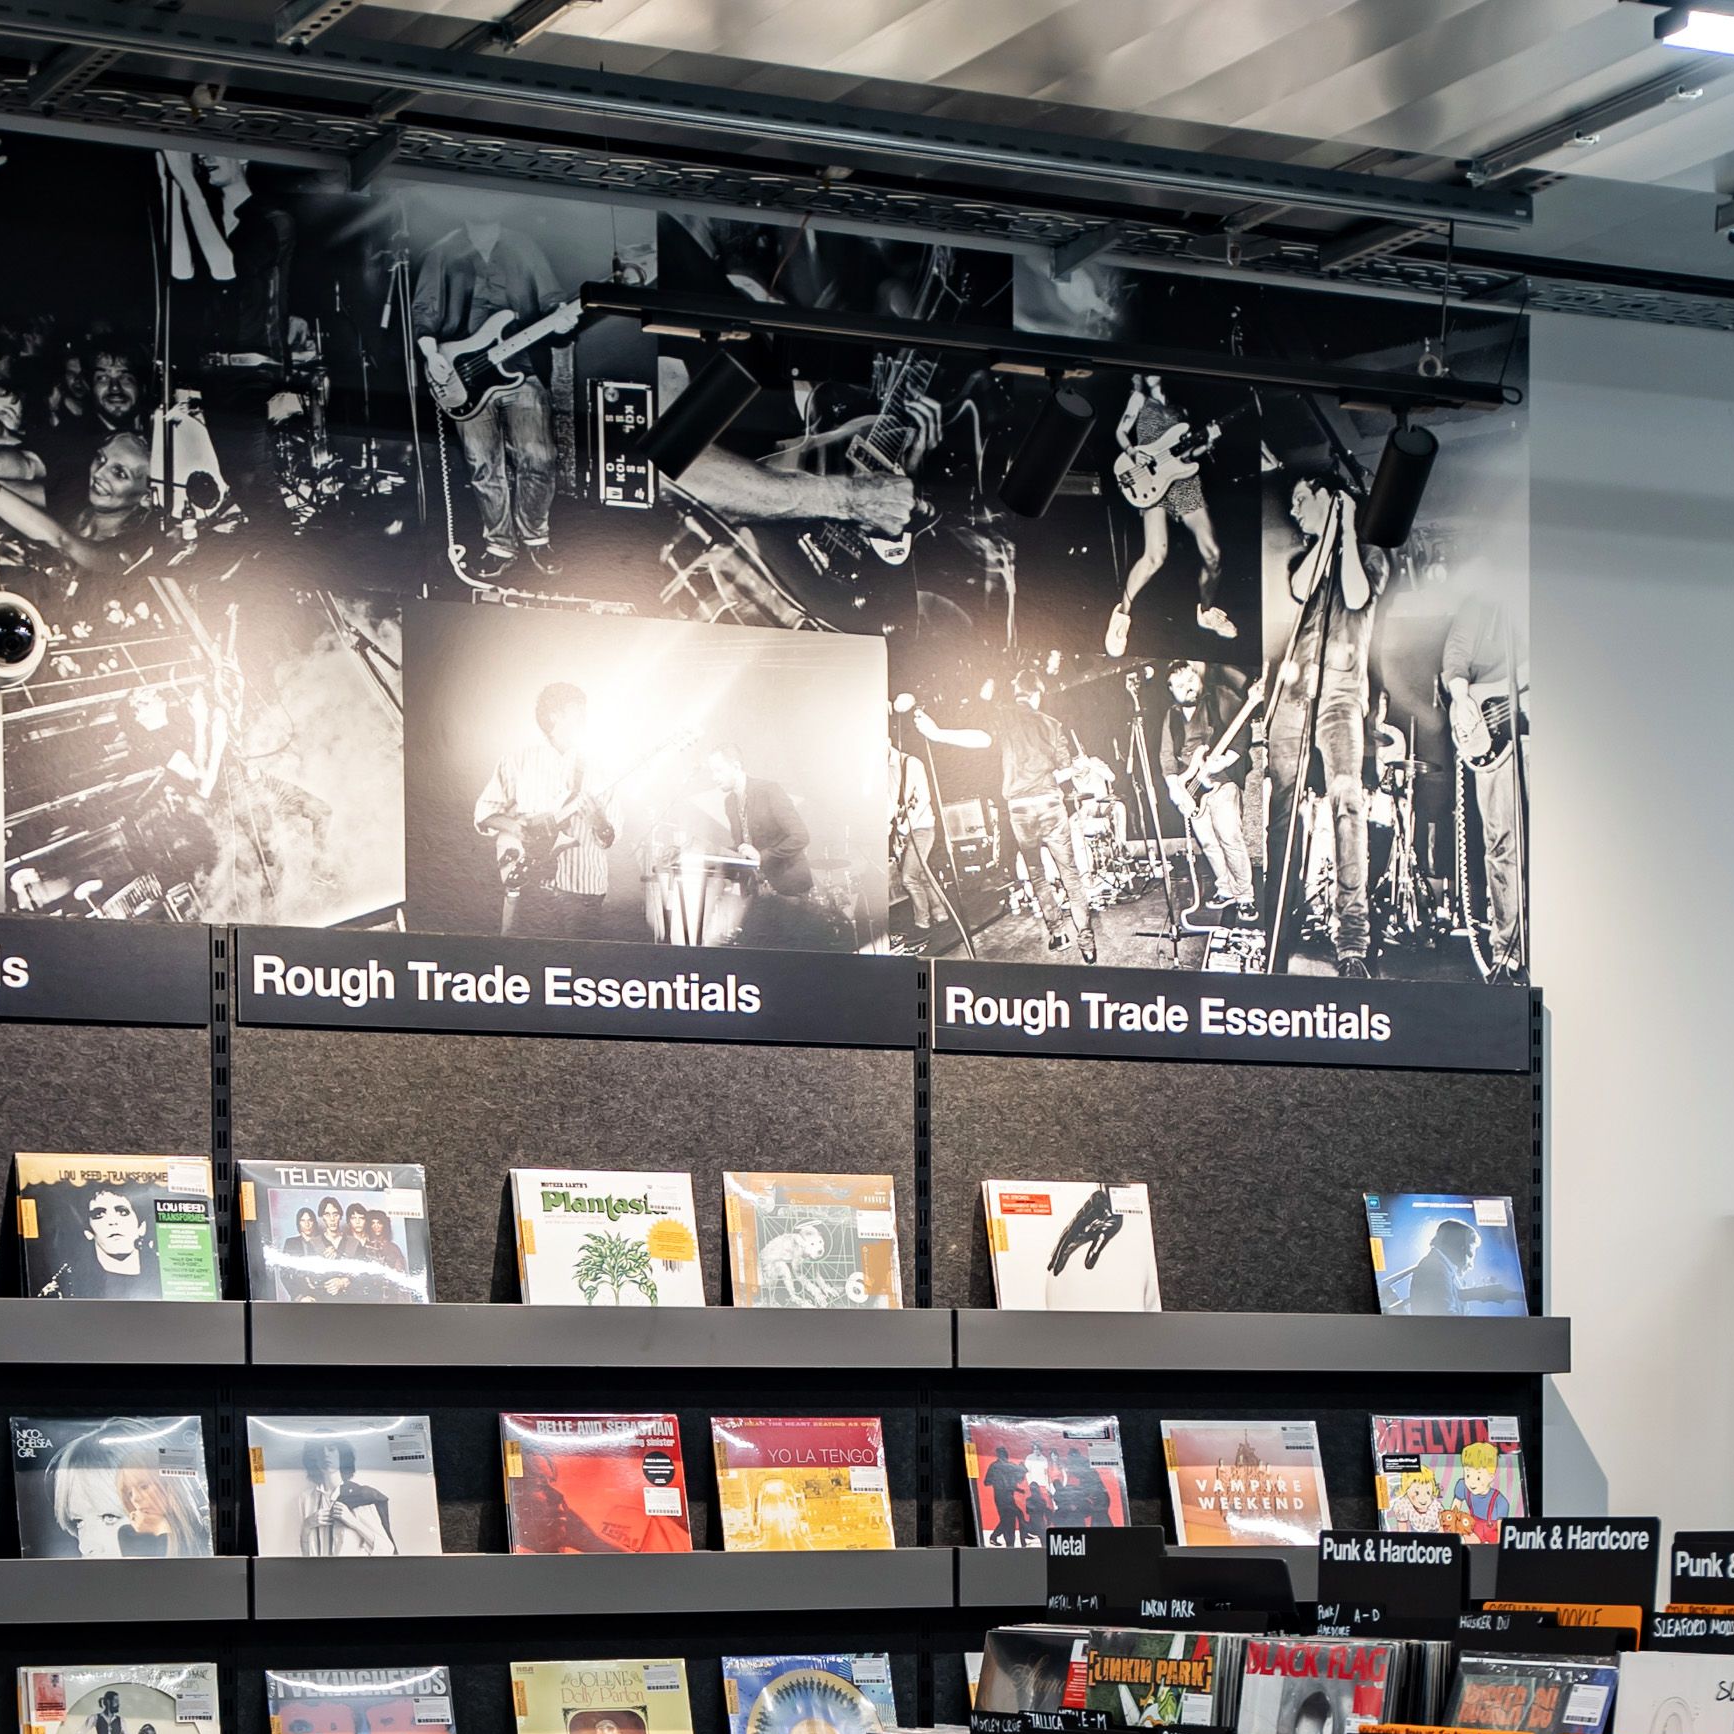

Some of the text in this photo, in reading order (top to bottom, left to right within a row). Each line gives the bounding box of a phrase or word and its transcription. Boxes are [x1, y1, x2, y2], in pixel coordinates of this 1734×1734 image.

[253, 955, 761, 1014] Rough Trade Essentials
[945, 987, 1391, 1042] Rough Trade Essentials
[157, 1202, 206, 1213] LOU REED
[541, 1189, 668, 1221] Plantasi
[537, 1420, 573, 1435] BELLE
[578, 1421, 602, 1435] AND
[767, 1449, 875, 1464] YO LA TENGO
[1196, 1479, 1303, 1494] VAMPIRE
[1197, 1496, 1304, 1511] WEEKEND
[1050, 1535, 1086, 1556] Metal
[1504, 1525, 1649, 1550] Punk & Hardcore
[1323, 1538, 1452, 1564] Punk & Hardcore
[1676, 1553, 1720, 1578] Punk
[1171, 1600, 1195, 1618] PARK
[1654, 1618, 1734, 1637] SLEAFORD MODS
[1156, 1659, 1207, 1686] PARK
[1247, 1641, 1388, 1681] BLACK FLAG
